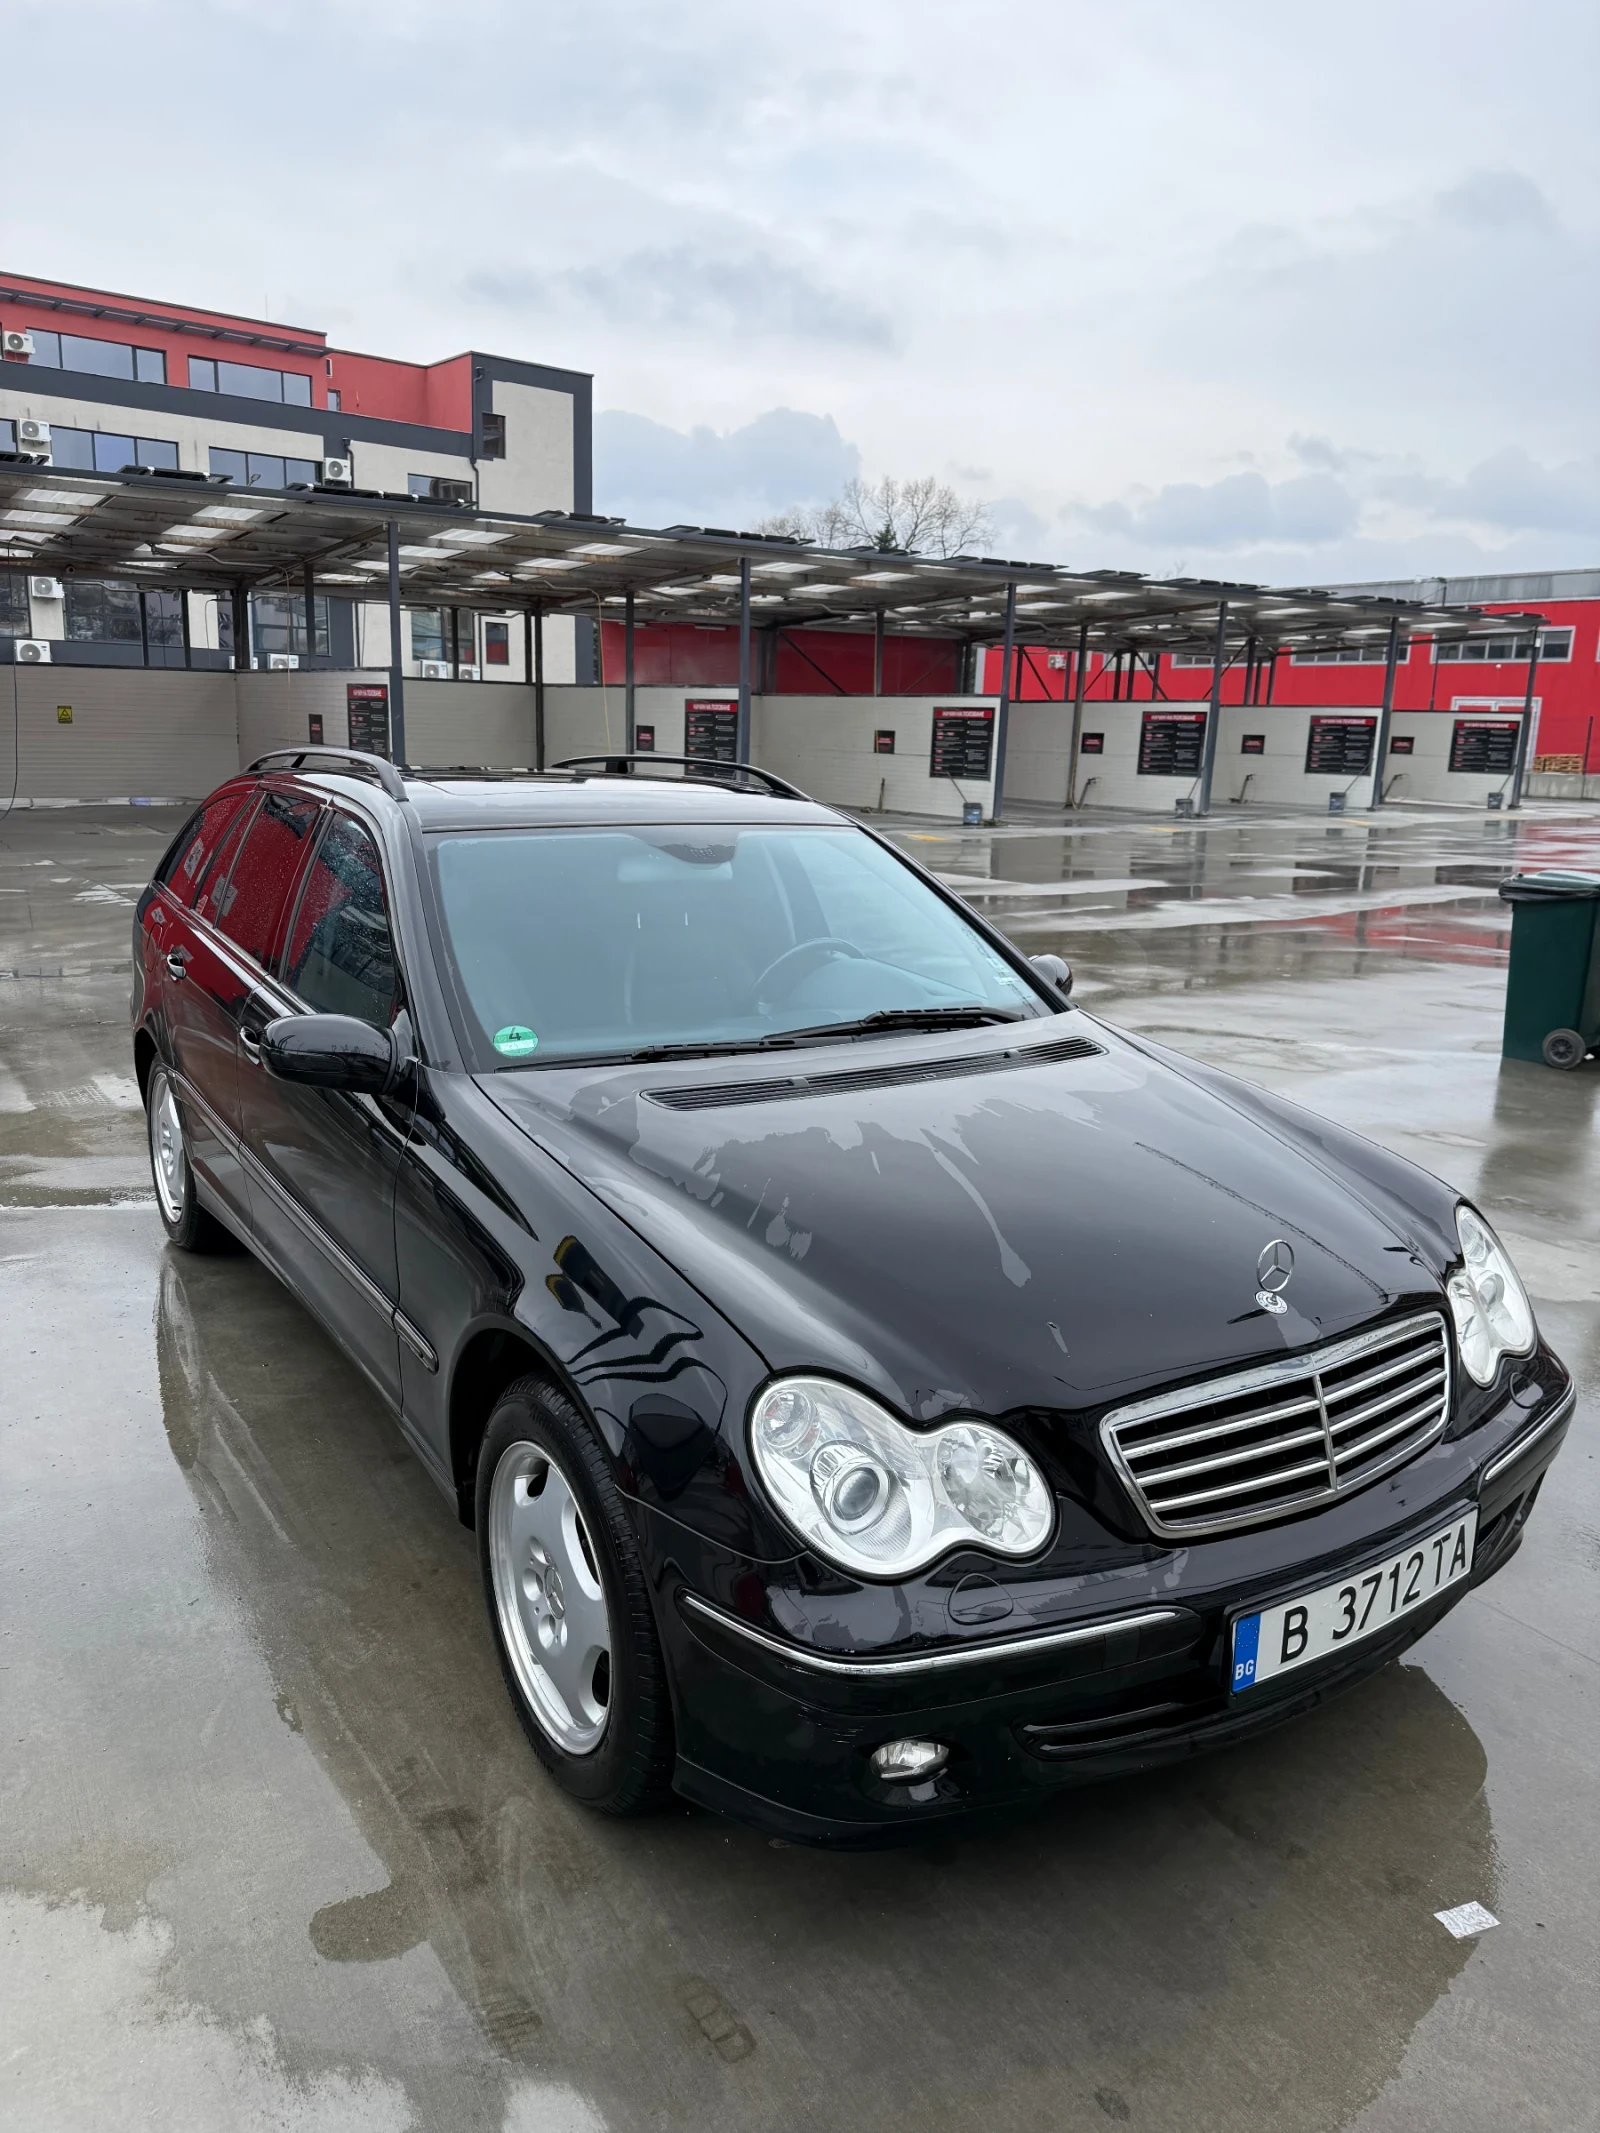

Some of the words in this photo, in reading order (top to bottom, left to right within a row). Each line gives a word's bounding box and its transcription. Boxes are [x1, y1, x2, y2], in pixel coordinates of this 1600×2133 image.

[509, 1027, 521, 1040] 4
[1280, 1604, 1309, 1665] B
[1331, 1551, 1424, 1640] 3712
[1432, 1523, 1467, 1587] TA
[1234, 1659, 1255, 1681] BG
